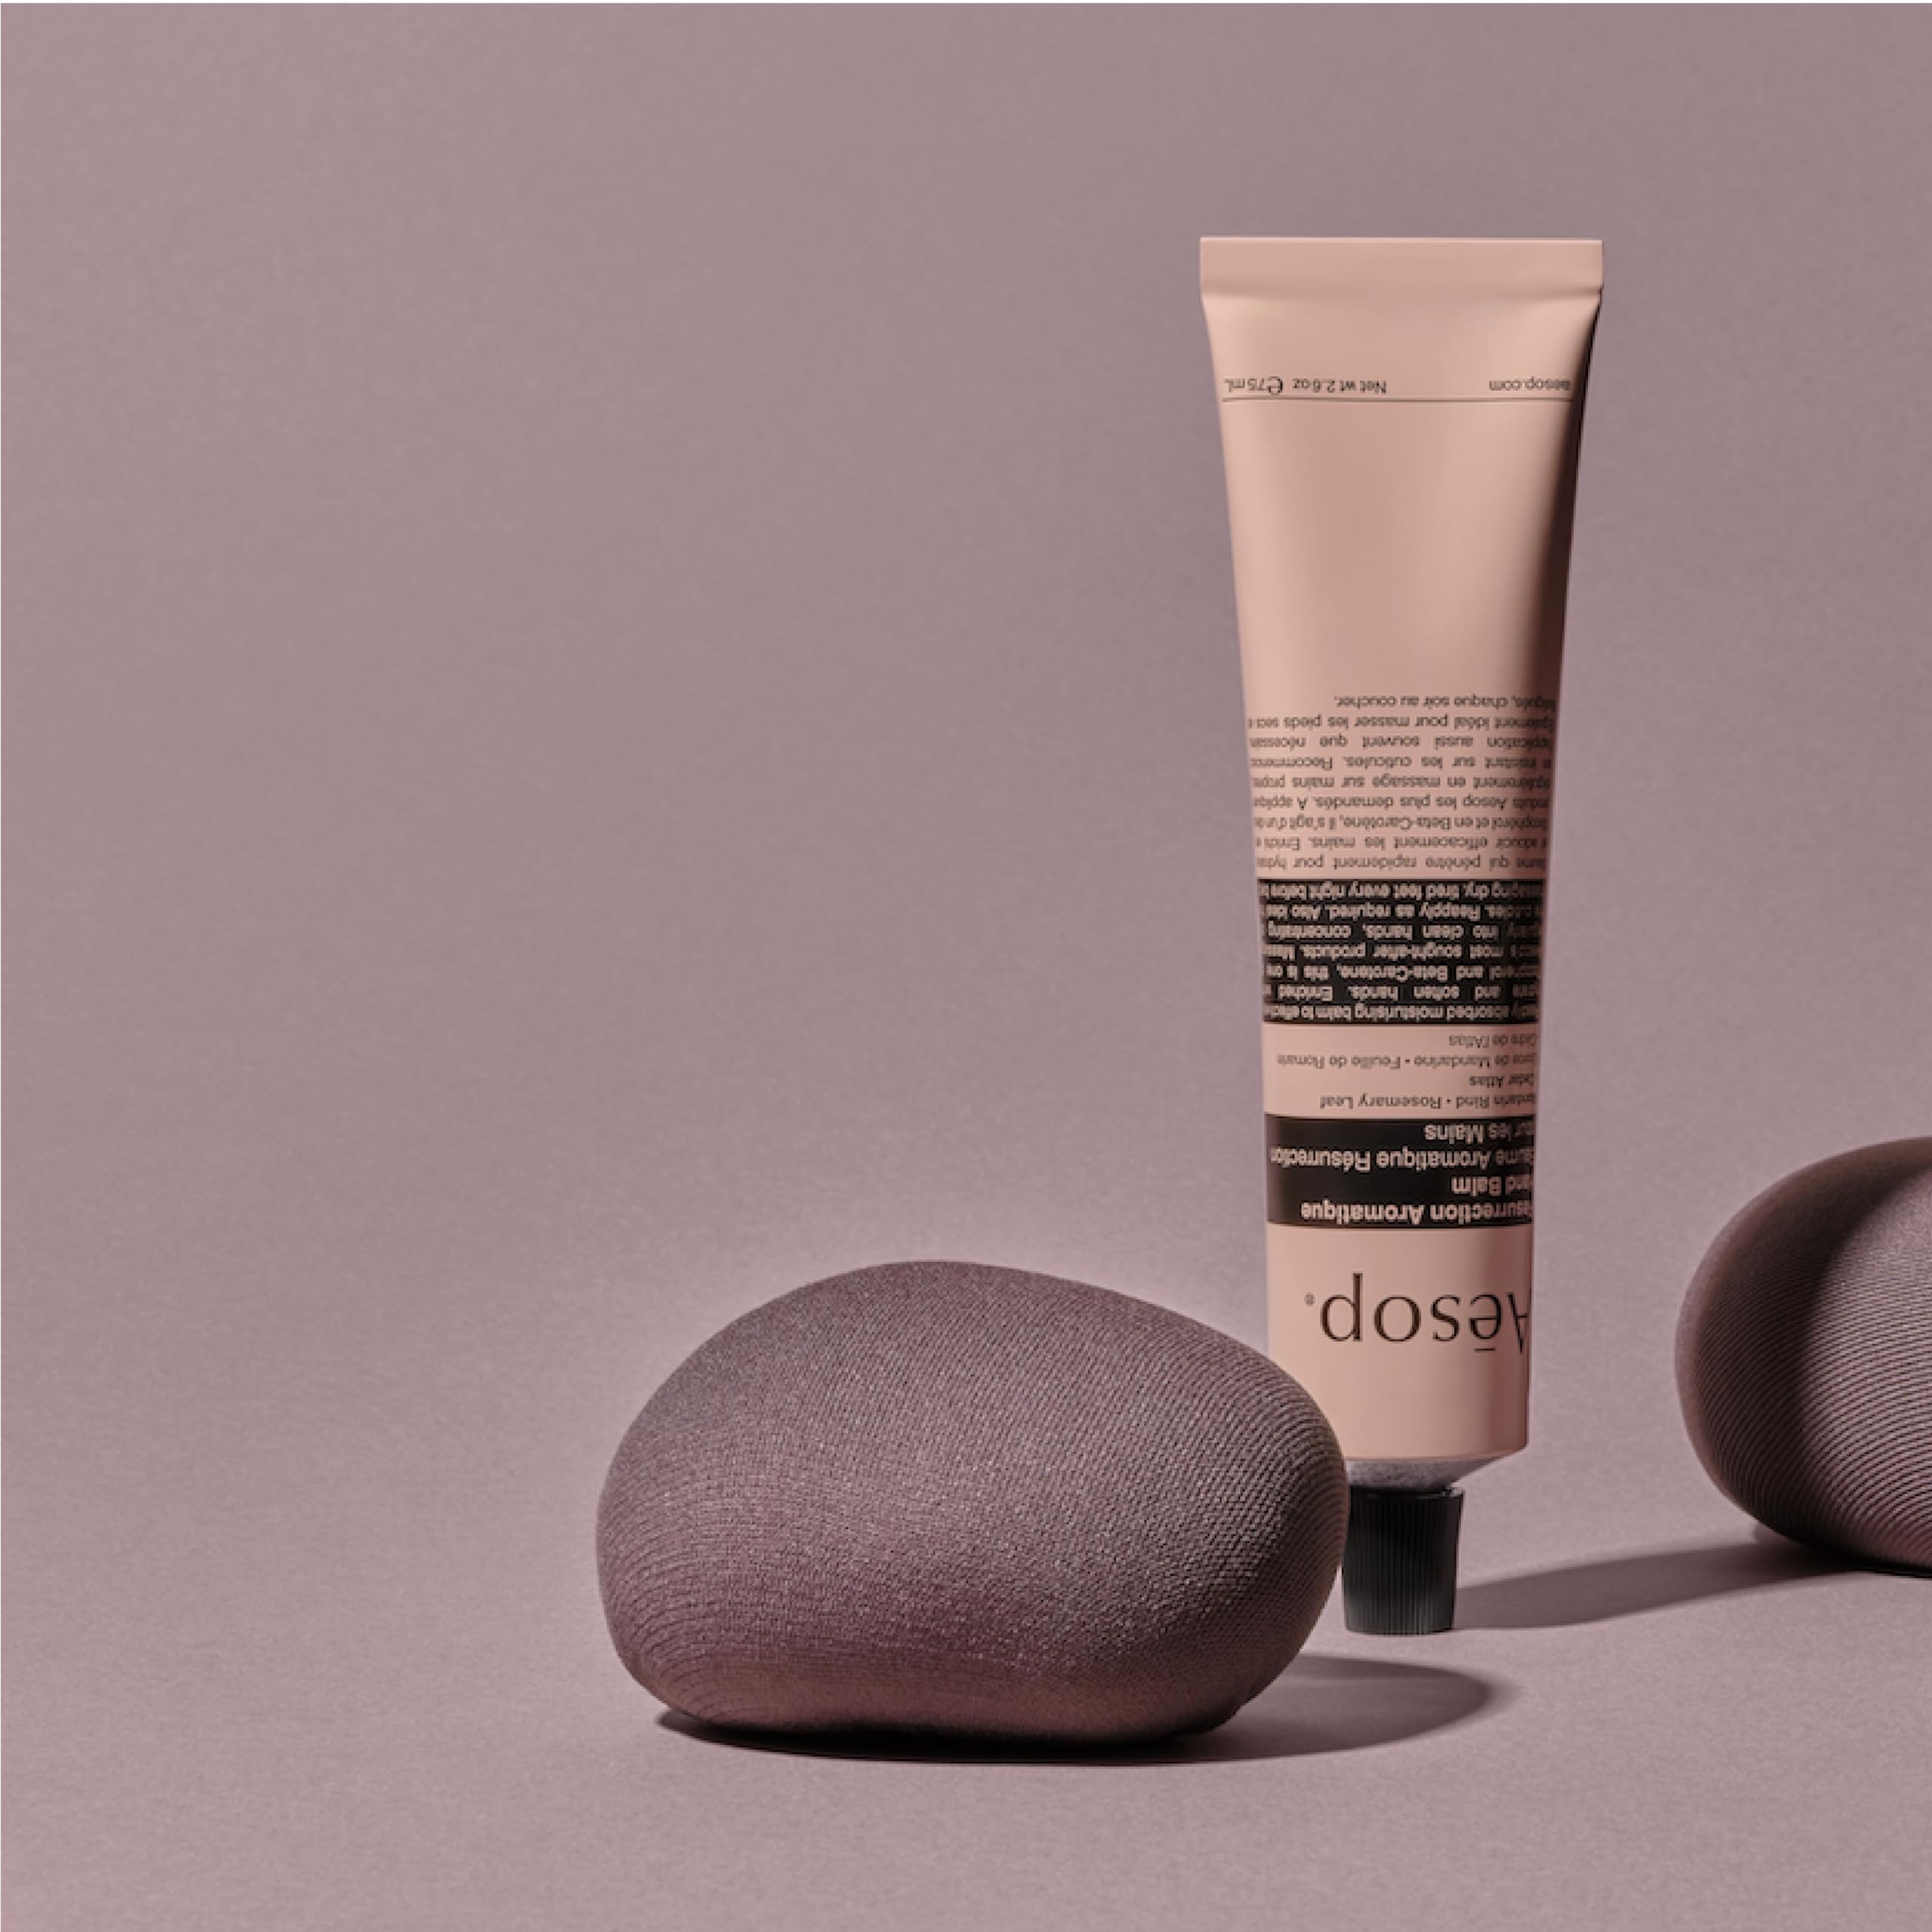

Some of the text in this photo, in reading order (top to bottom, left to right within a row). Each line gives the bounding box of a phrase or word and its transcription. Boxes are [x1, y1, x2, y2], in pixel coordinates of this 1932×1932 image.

[1339, 380, 1355, 392] wt
[1360, 380, 1386, 395] Net
[1489, 377, 1570, 391] aesop.com
[1334, 695, 1396, 709] coucher.
[1400, 696, 1419, 707] au
[1423, 696, 1450, 709] soir
[1454, 693, 1509, 709] chaque
[1284, 714, 1322, 731] pieds
[1327, 717, 1349, 729] les
[1355, 717, 1410, 727] masser
[1415, 713, 1448, 727] pour
[1454, 717, 1489, 731] idéal
[1320, 734, 1348, 748] que
[1362, 736, 1420, 747] souvent
[1435, 737, 1473, 750] aussi
[1341, 757, 1412, 769] cuticules.
[1421, 757, 1443, 769] les
[1452, 757, 1475, 767] sur
[1292, 777, 1334, 791] mains
[1341, 777, 1365, 788] sur
[1372, 774, 1440, 788] massage
[1447, 777, 1466, 788] en
[1297, 797, 1307, 811] A
[1313, 797, 1393, 811] demandés.
[1401, 794, 1431, 810] plus
[1436, 797, 1457, 811] les
[1463, 795, 1506, 811] Aesop
[1290, 814, 1325, 830] s'agit
[1330, 817, 1337, 830] il
[1340, 815, 1451, 831] Beta-Carotène,
[1454, 817, 1473, 827] en
[1476, 817, 1489, 829] et
[1309, 837, 1355, 850] mains.
[1365, 838, 1386, 850] les
[1394, 838, 1487, 851] efficacement
[1294, 855, 1324, 867] pour
[1333, 855, 1417, 870] rapidement
[1426, 855, 1481, 871] pénètre
[1490, 855, 1509, 870] qui
[1309, 881, 1344, 900] night
[1347, 880, 1390, 899] every
[1393, 885, 1423, 901] feet
[1425, 884, 1459, 900] tired
[1463, 880, 1490, 900] dry,
[1291, 904, 1321, 920] Also
[1324, 902, 1391, 921] required.
[1395, 904, 1414, 918] as
[1420, 902, 1480, 921] Reapply
[1362, 924, 1413, 940] hands,
[1423, 925, 1463, 940] clean
[1472, 925, 1499, 940] into
[1299, 942, 1365, 961] products.
[1373, 942, 1462, 961] sought-after
[1470, 945, 1503, 959] most
[1286, 966, 1297, 980] is
[1303, 965, 1328, 980] this
[1336, 965, 1447, 983] Beta-Carotene,
[1456, 966, 1483, 980] and
[1278, 984, 1333, 1001] Enriched
[1348, 986, 1398, 1001] hands.
[1414, 986, 1460, 1001] soften
[1475, 986, 1502, 1001] and
[1302, 1005, 1314, 1020] to
[1315, 1005, 1351, 1021] balm
[1355, 1003, 1443, 1022] moisturising
[1447, 1005, 1509, 1020] absorbed
[1450, 1035, 1489, 1049] l'Atlas
[1351, 1055, 1401, 1069] Feuille
[1414, 1056, 1490, 1069] Mandarine
[1469, 1076, 1504, 1089] Atlas
[1320, 1097, 1354, 1109] Leaf
[1358, 1093, 1441, 1109] Rosemary
[1456, 1097, 1490, 1109] Rind
[1423, 1124, 1483, 1145] Mains
[1377, 1146, 1491, 1171] Aromatique
[1451, 1176, 1502, 1196] Balm
[1300, 1198, 1534, 1225] esurrection Aromatique
